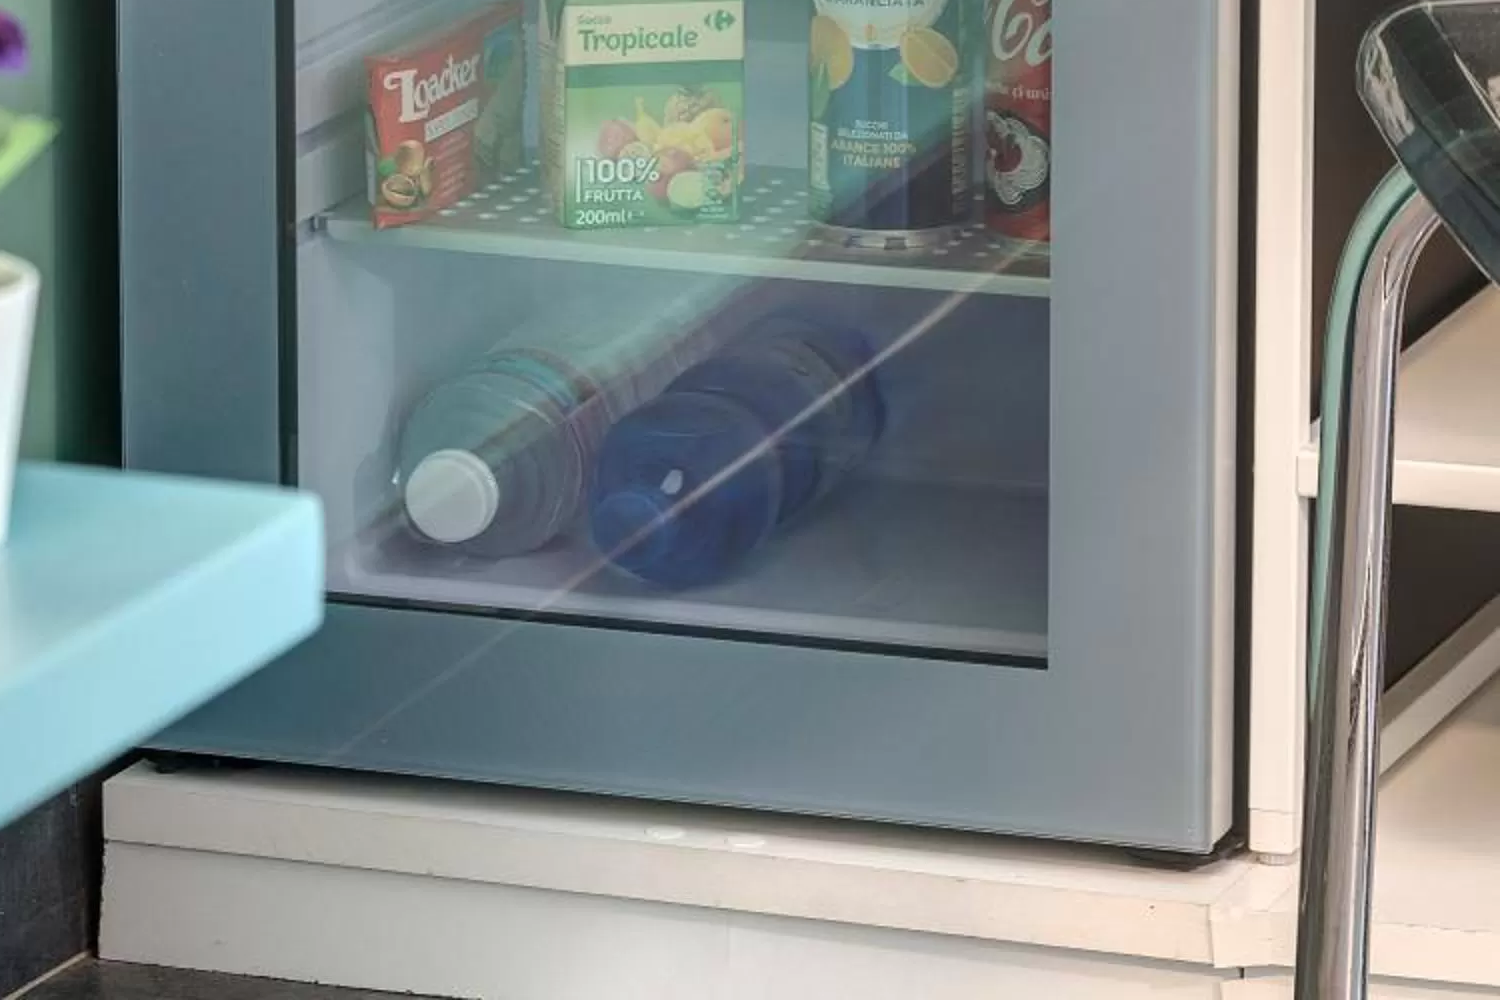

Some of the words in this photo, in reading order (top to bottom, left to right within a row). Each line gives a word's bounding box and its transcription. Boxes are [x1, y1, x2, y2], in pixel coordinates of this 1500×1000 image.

[578, 24, 698, 56] Tropicale
[384, 53, 480, 124] Loacker
[584, 157, 659, 184] 100%
[583, 188, 644, 203] FRUTTA
[575, 207, 627, 225] 200ml
